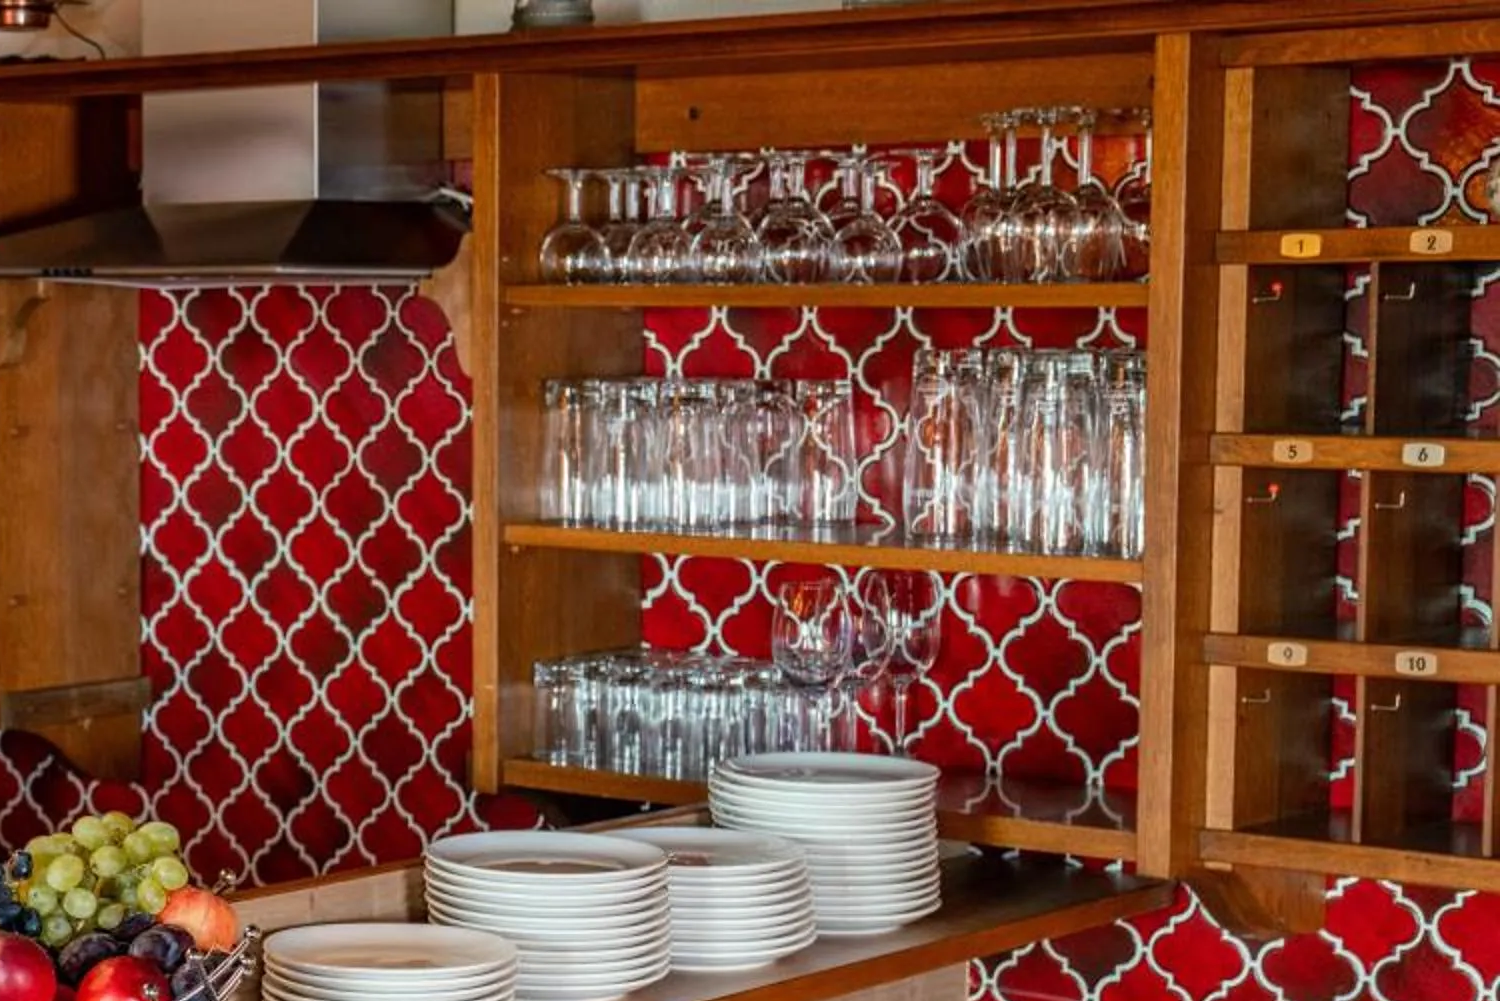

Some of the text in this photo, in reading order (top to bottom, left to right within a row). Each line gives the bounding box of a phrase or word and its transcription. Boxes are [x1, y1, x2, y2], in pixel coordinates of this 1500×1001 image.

[1427, 235, 1438, 250] 2
[1287, 445, 1298, 459] 5
[1417, 447, 1429, 463] 6
[1408, 656, 1427, 672] 10
